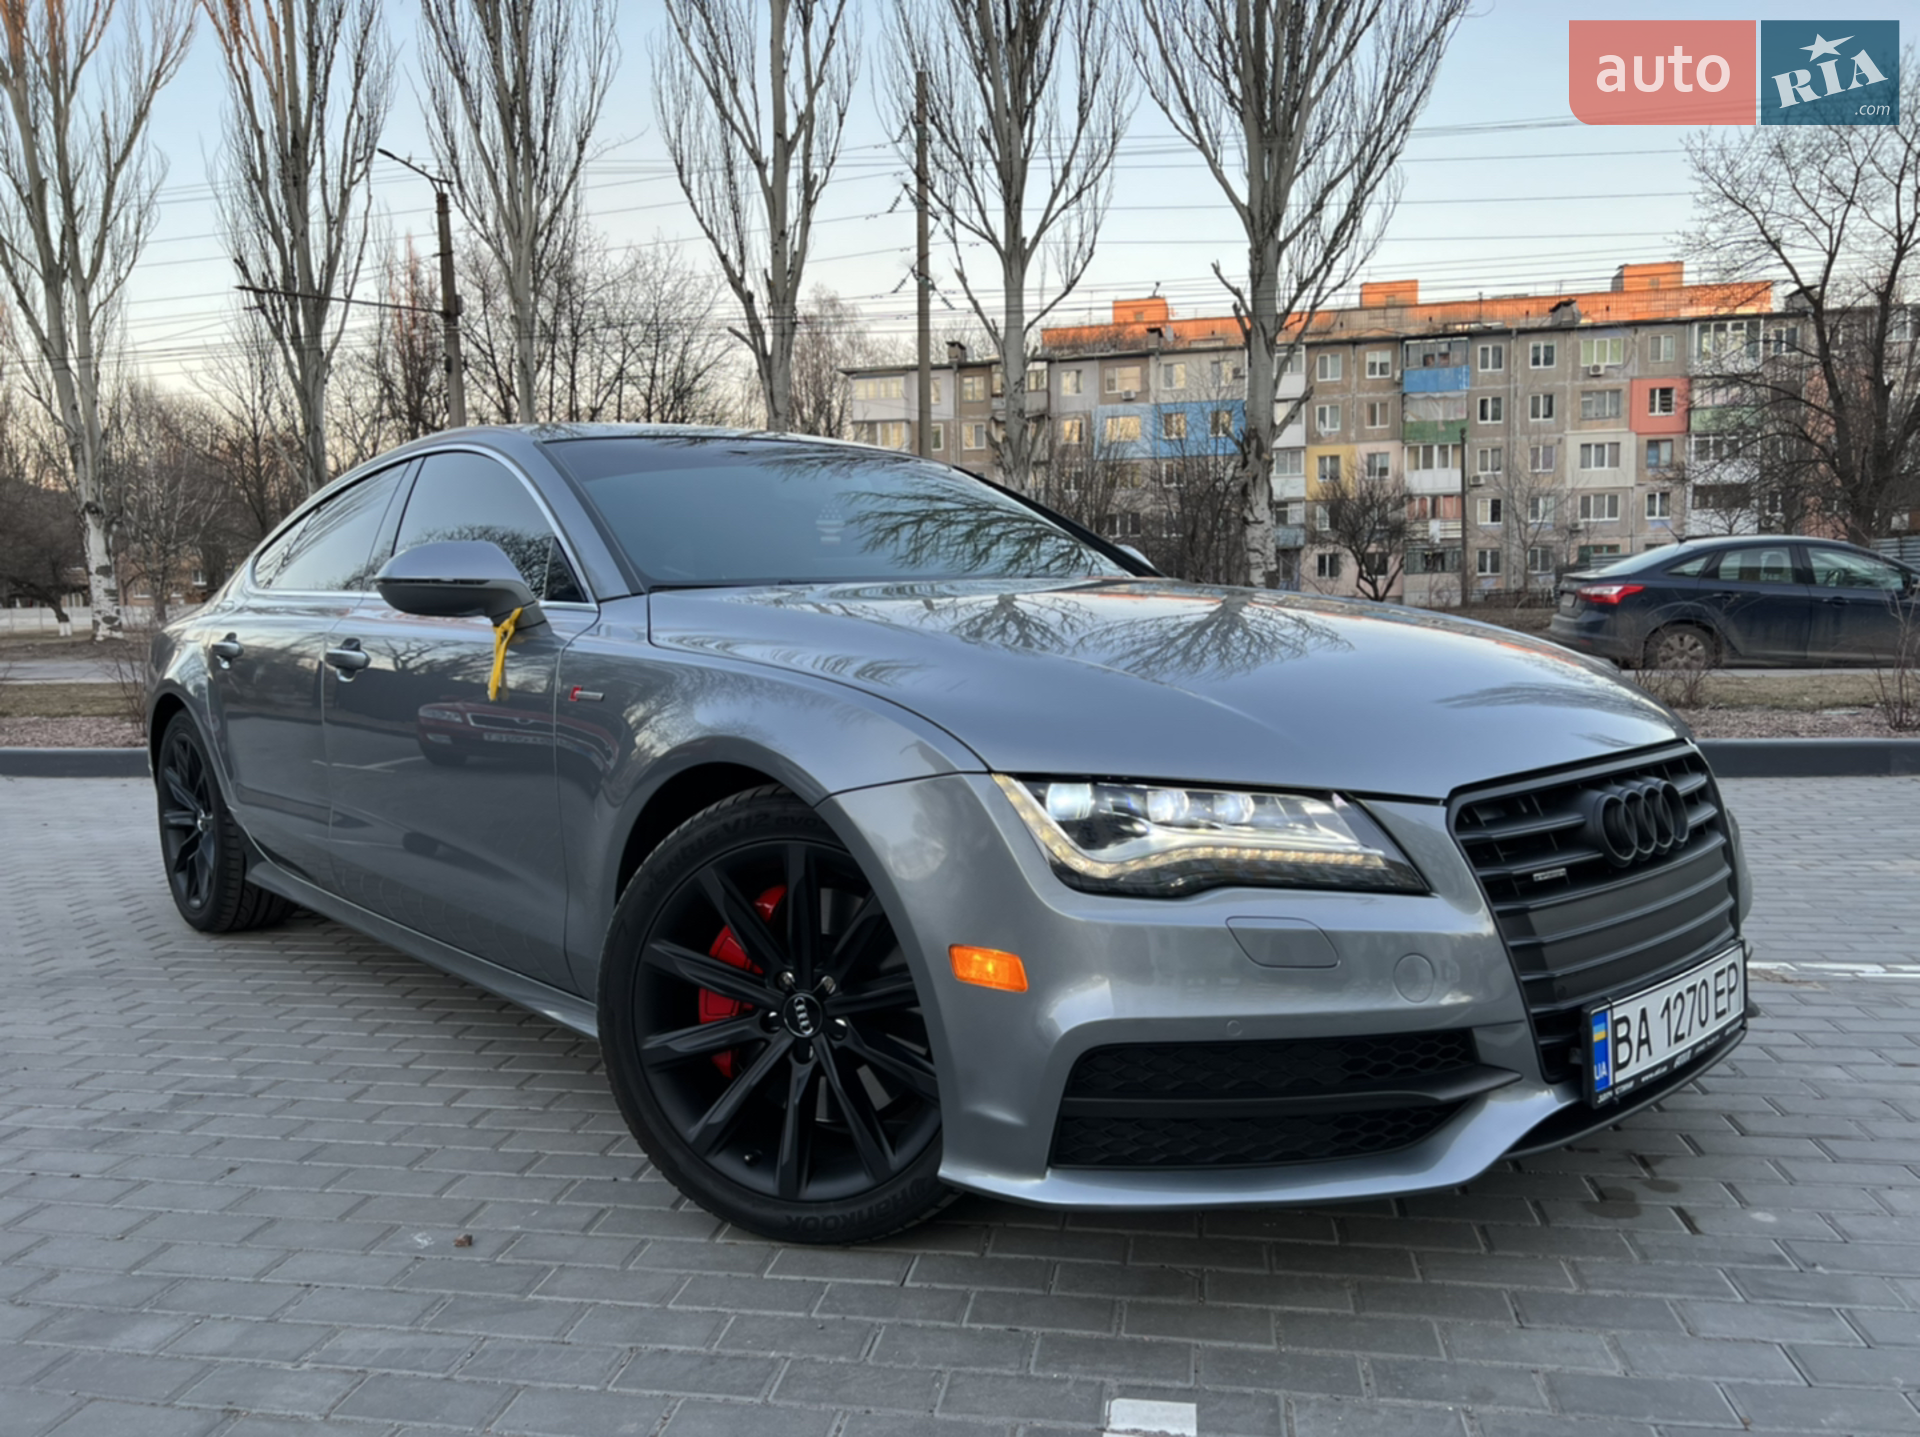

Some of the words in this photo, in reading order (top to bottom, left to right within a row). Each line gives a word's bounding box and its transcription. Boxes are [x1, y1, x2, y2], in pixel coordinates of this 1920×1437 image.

[1614, 1006, 1652, 1073] BA
[1660, 978, 1709, 1048] 1270
[1714, 961, 1739, 1021] EP
[1594, 1061, 1608, 1081] UA
